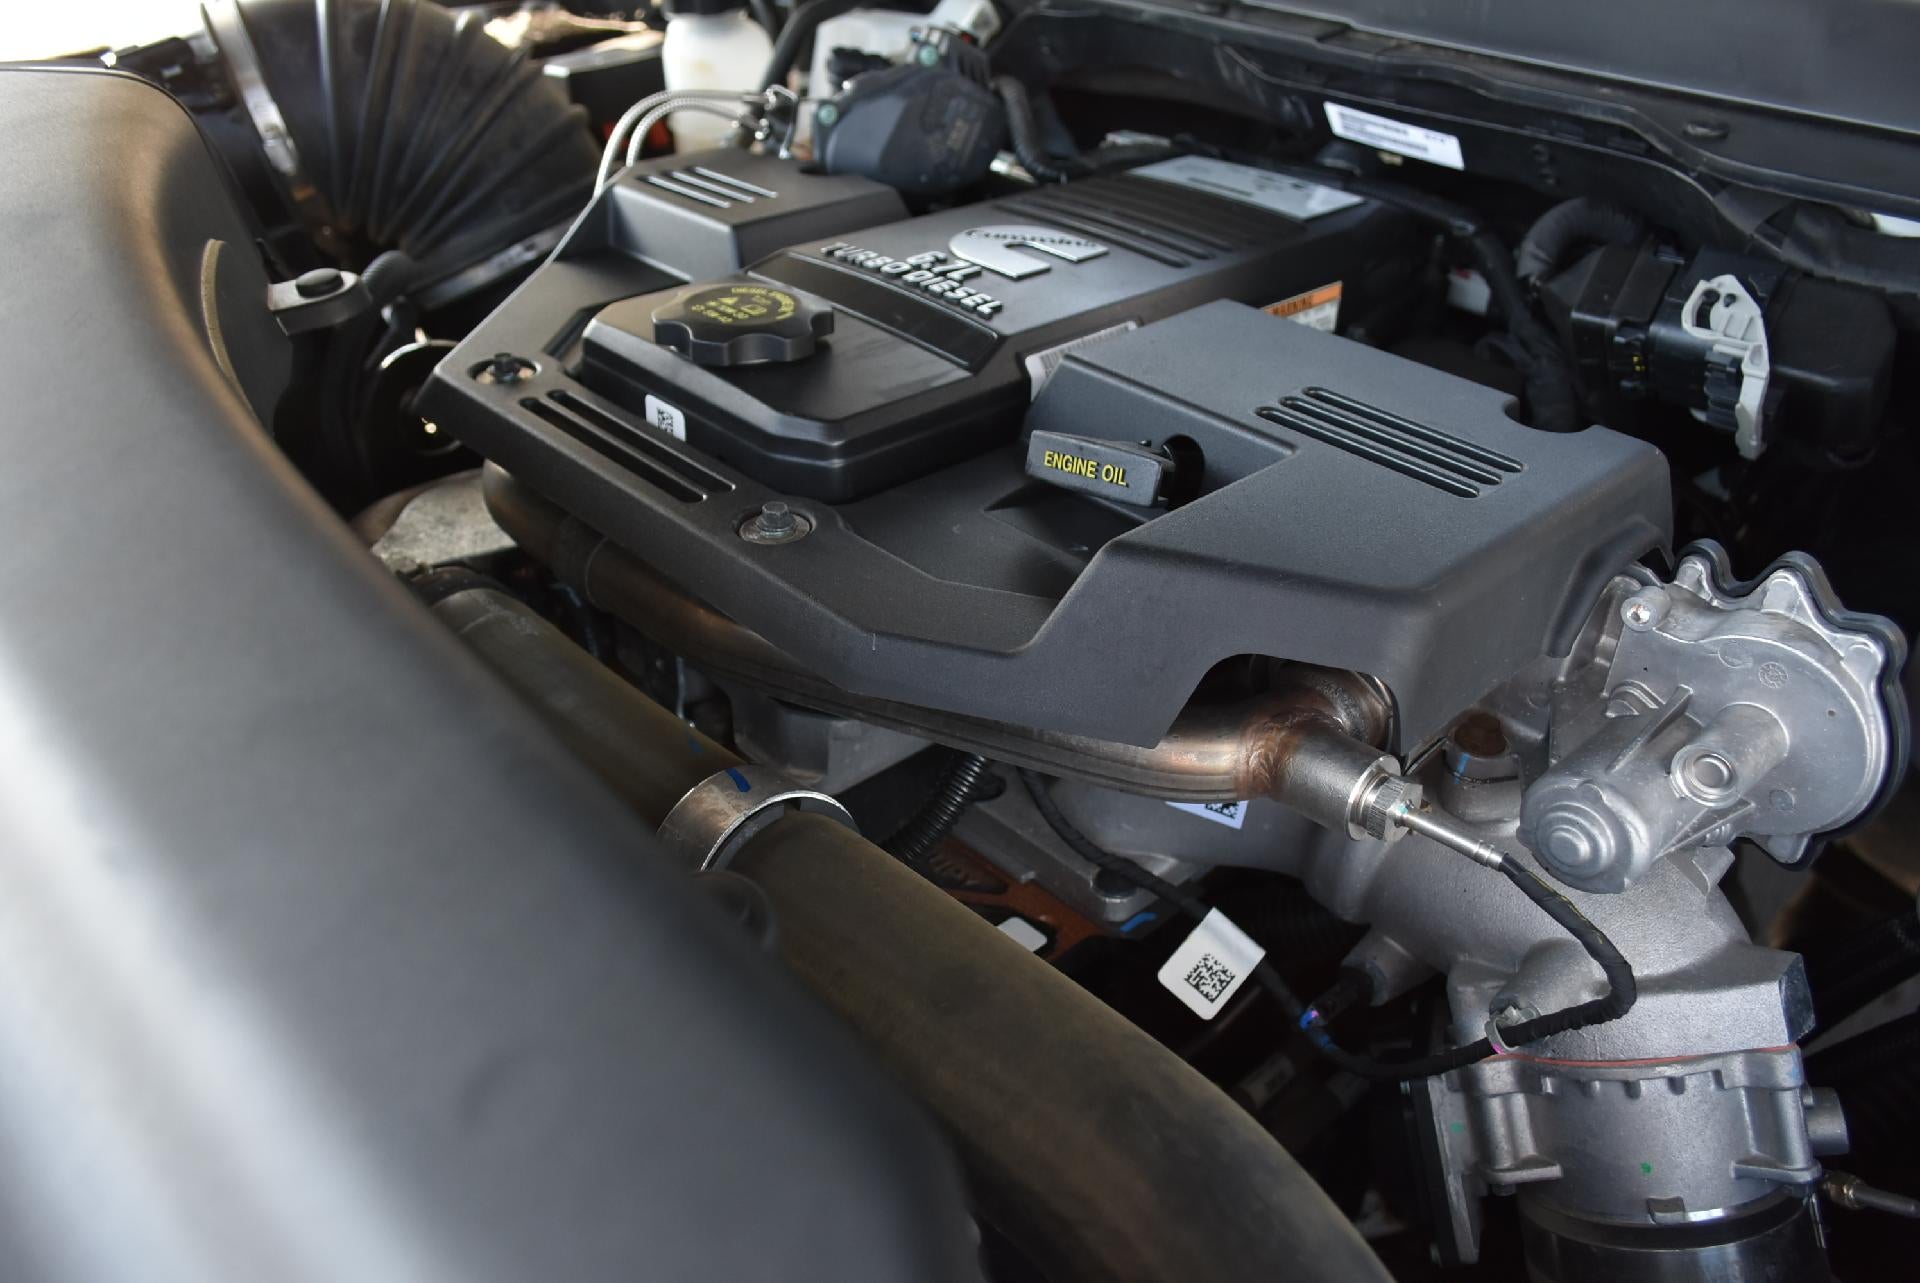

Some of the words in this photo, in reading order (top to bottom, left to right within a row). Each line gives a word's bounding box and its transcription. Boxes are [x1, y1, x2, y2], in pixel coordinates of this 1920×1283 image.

[820, 242, 912, 277] TURBO
[902, 270, 1003, 319] DIESEL
[1044, 450, 1097, 479] ENGINE
[1102, 464, 1128, 487] OIL
